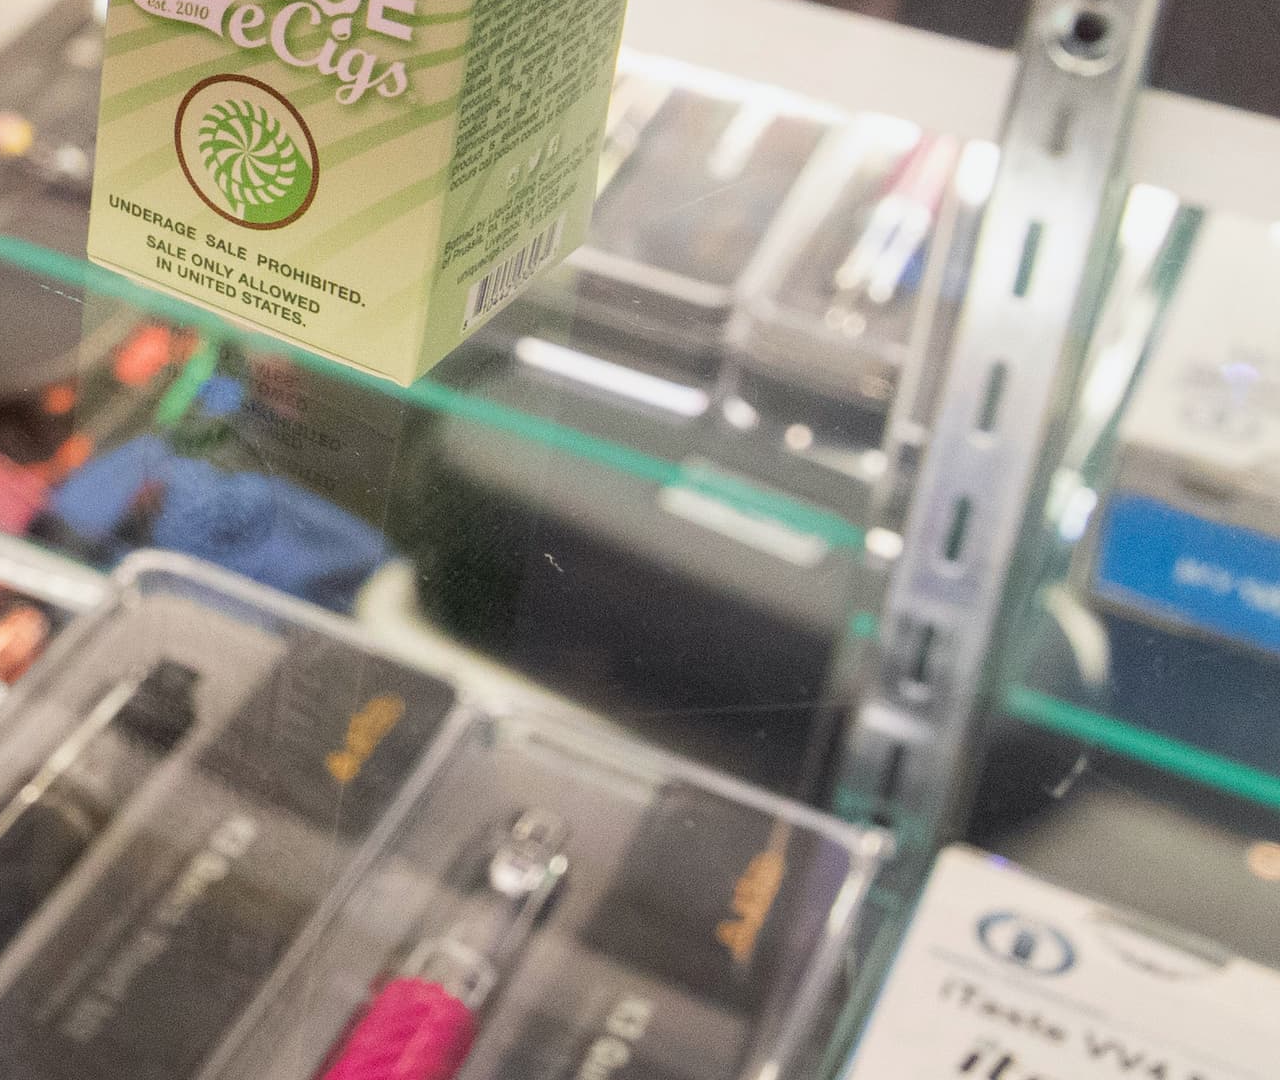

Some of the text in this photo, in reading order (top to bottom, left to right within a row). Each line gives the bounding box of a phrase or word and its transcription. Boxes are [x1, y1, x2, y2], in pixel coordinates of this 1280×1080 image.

[176, 0, 210, 21] 2010
[229, 1, 408, 105] eCigs
[109, 194, 366, 308] UNDERAGE SALE PROHIBITED.
[146, 235, 320, 314] SALE ONLY ALLOWED
[156, 256, 307, 327] IN UNITED STATES.
